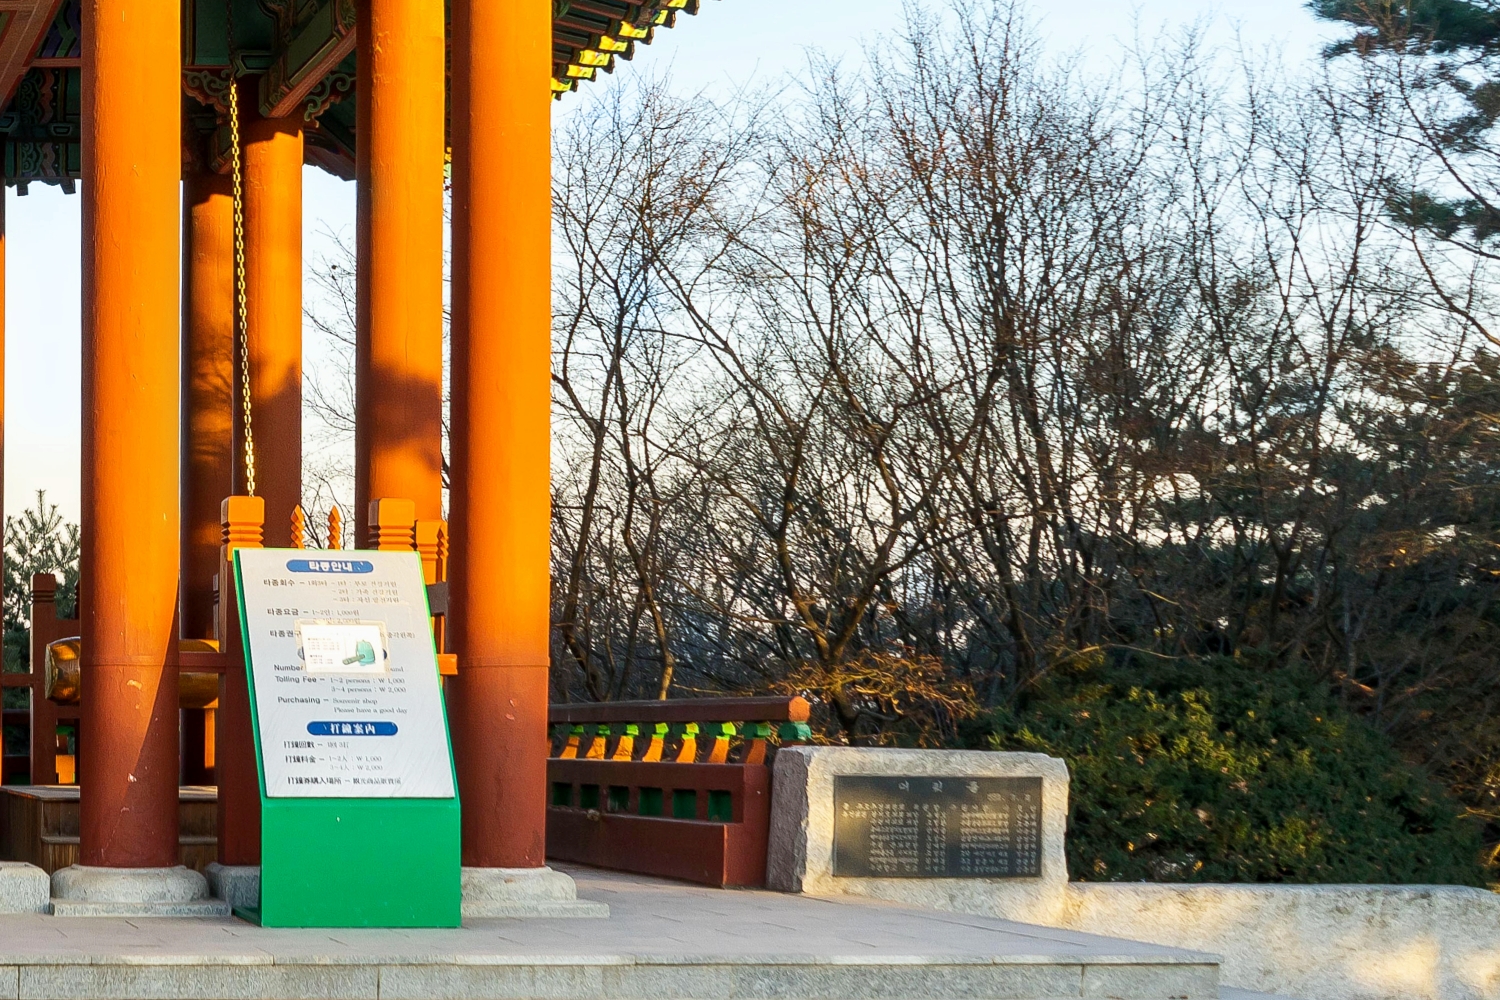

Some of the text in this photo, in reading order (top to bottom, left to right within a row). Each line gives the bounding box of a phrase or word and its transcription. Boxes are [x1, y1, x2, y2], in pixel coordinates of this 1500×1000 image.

[308, 560, 353, 572] 타종안내
[263, 579, 295, 587] 타종회수
[266, 608, 299, 616] 타종요금
[275, 675, 299, 683] Tolling
[277, 696, 320, 704] Purchasing
[362, 697, 378, 705] shop
[396, 706, 407, 714] day
